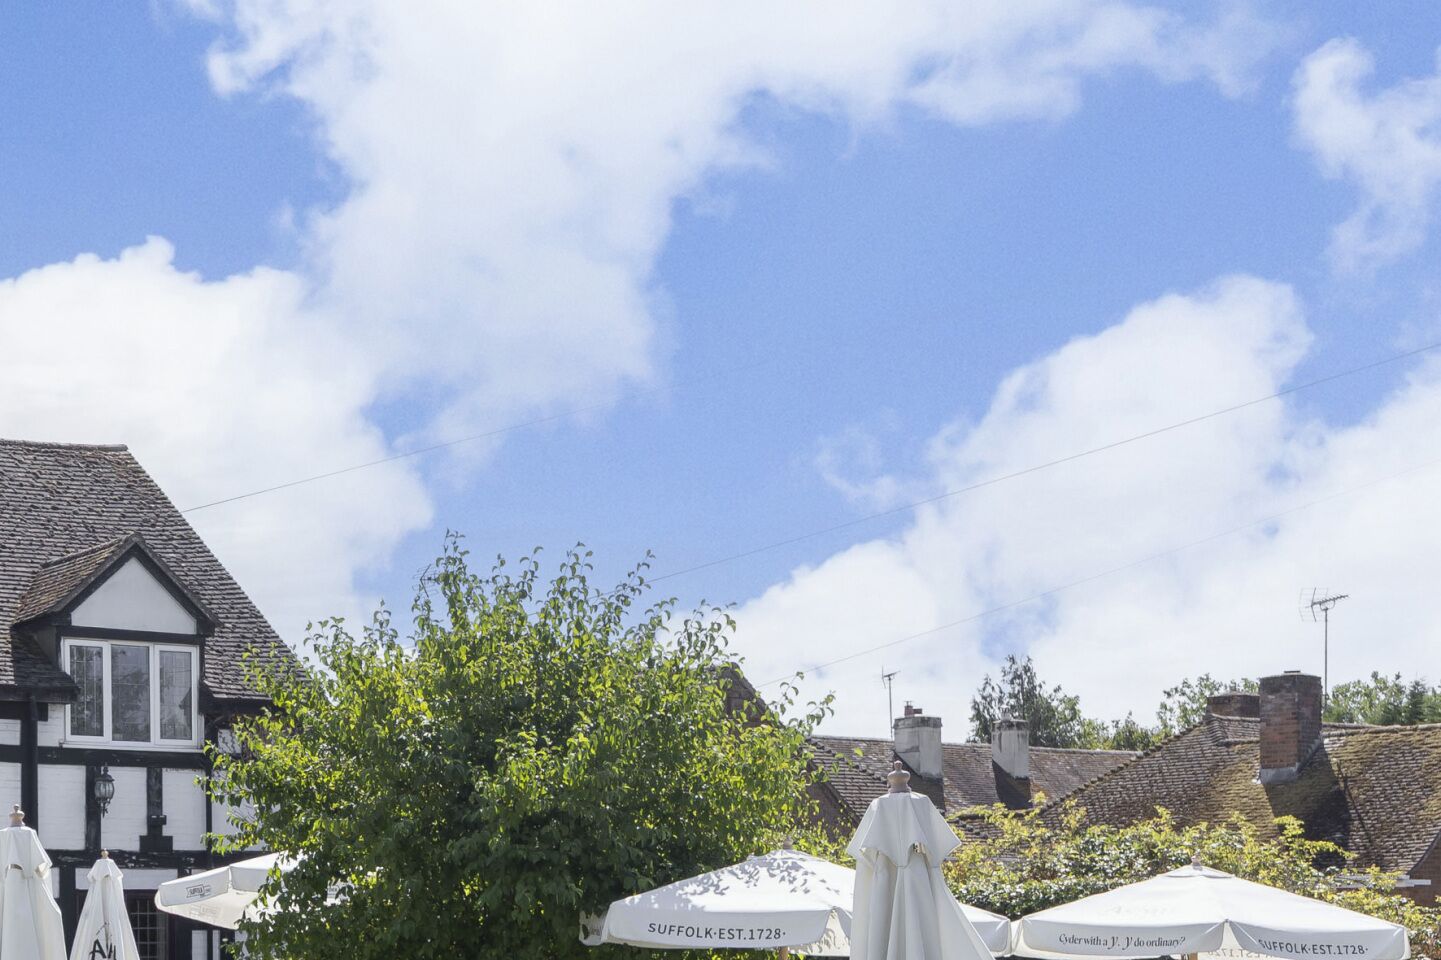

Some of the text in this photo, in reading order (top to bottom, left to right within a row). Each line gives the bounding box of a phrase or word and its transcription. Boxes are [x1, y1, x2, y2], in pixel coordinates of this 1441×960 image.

[1059, 933, 1084, 945] Cyder
[1084, 936, 1101, 946] with
[1133, 936, 1144, 947] do
[1146, 936, 1186, 948] ordinary?
